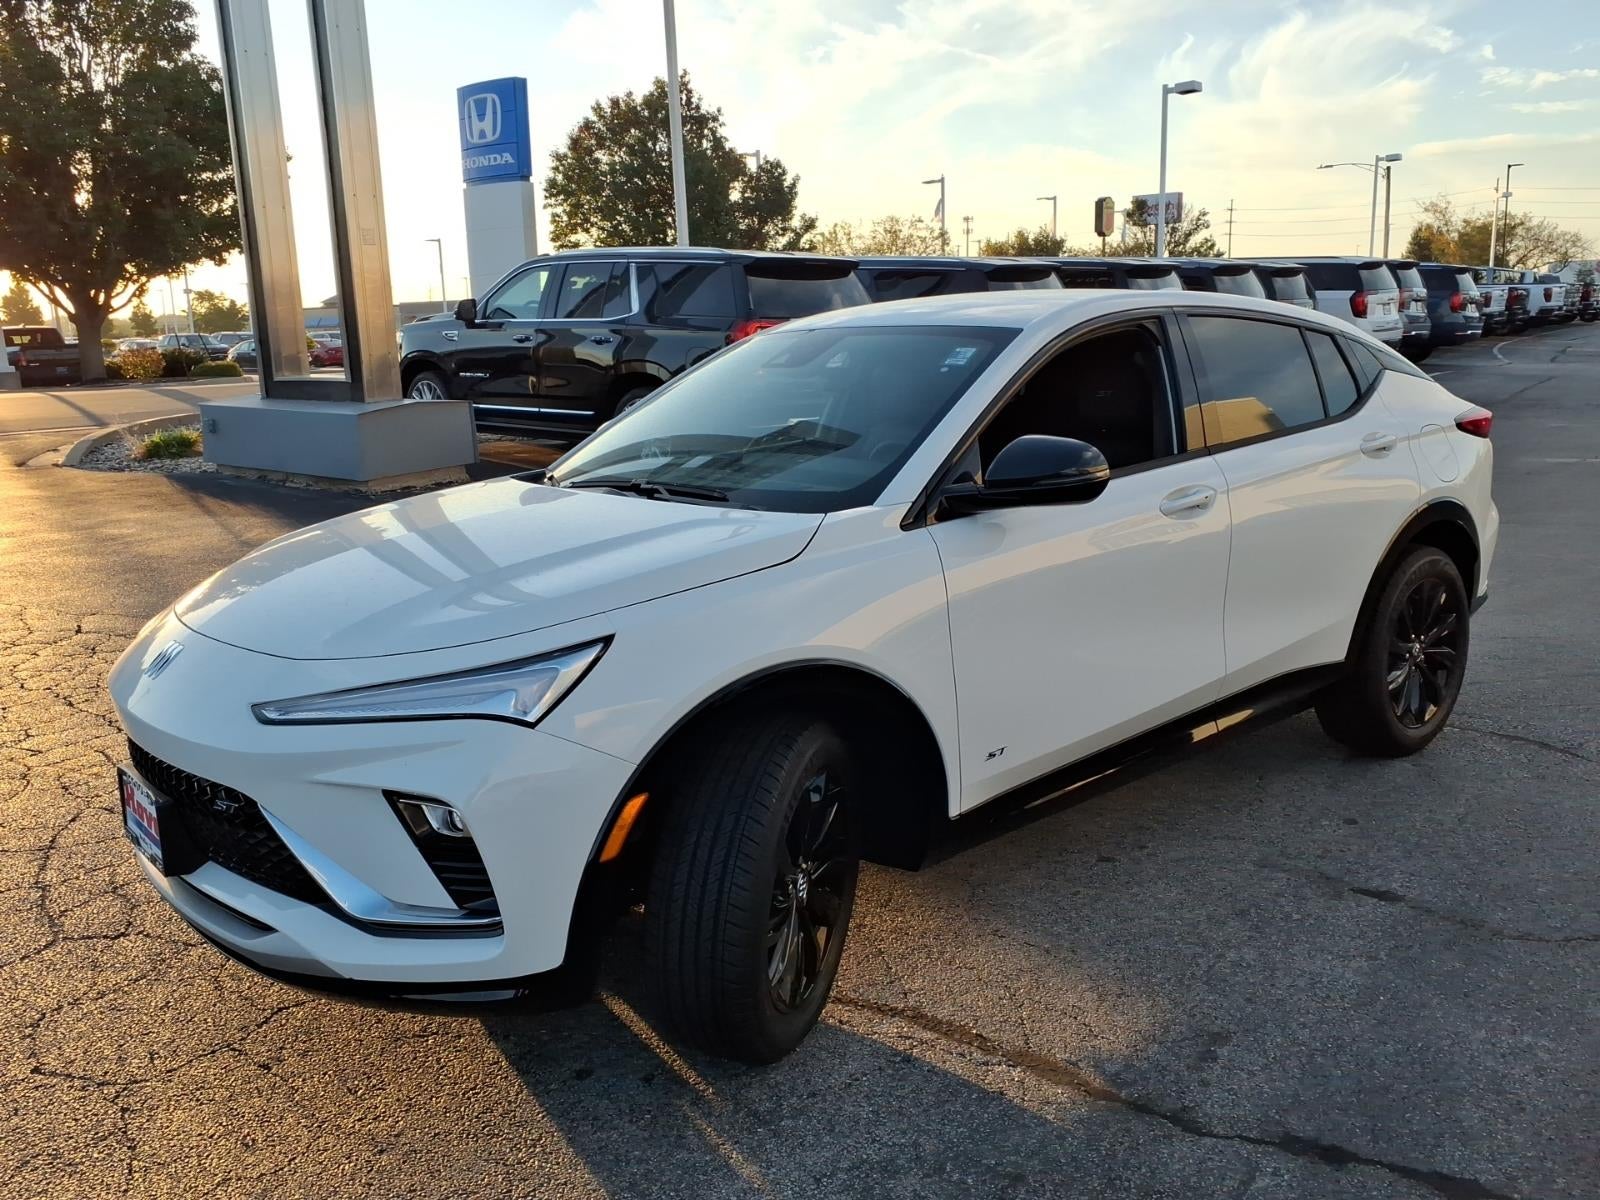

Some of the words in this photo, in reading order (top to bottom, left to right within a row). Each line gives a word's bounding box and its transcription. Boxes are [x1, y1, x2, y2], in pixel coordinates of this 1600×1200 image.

[463, 152, 515, 169] HONDA
[985, 746, 1008, 762] ST
[213, 799, 239, 813] ST
